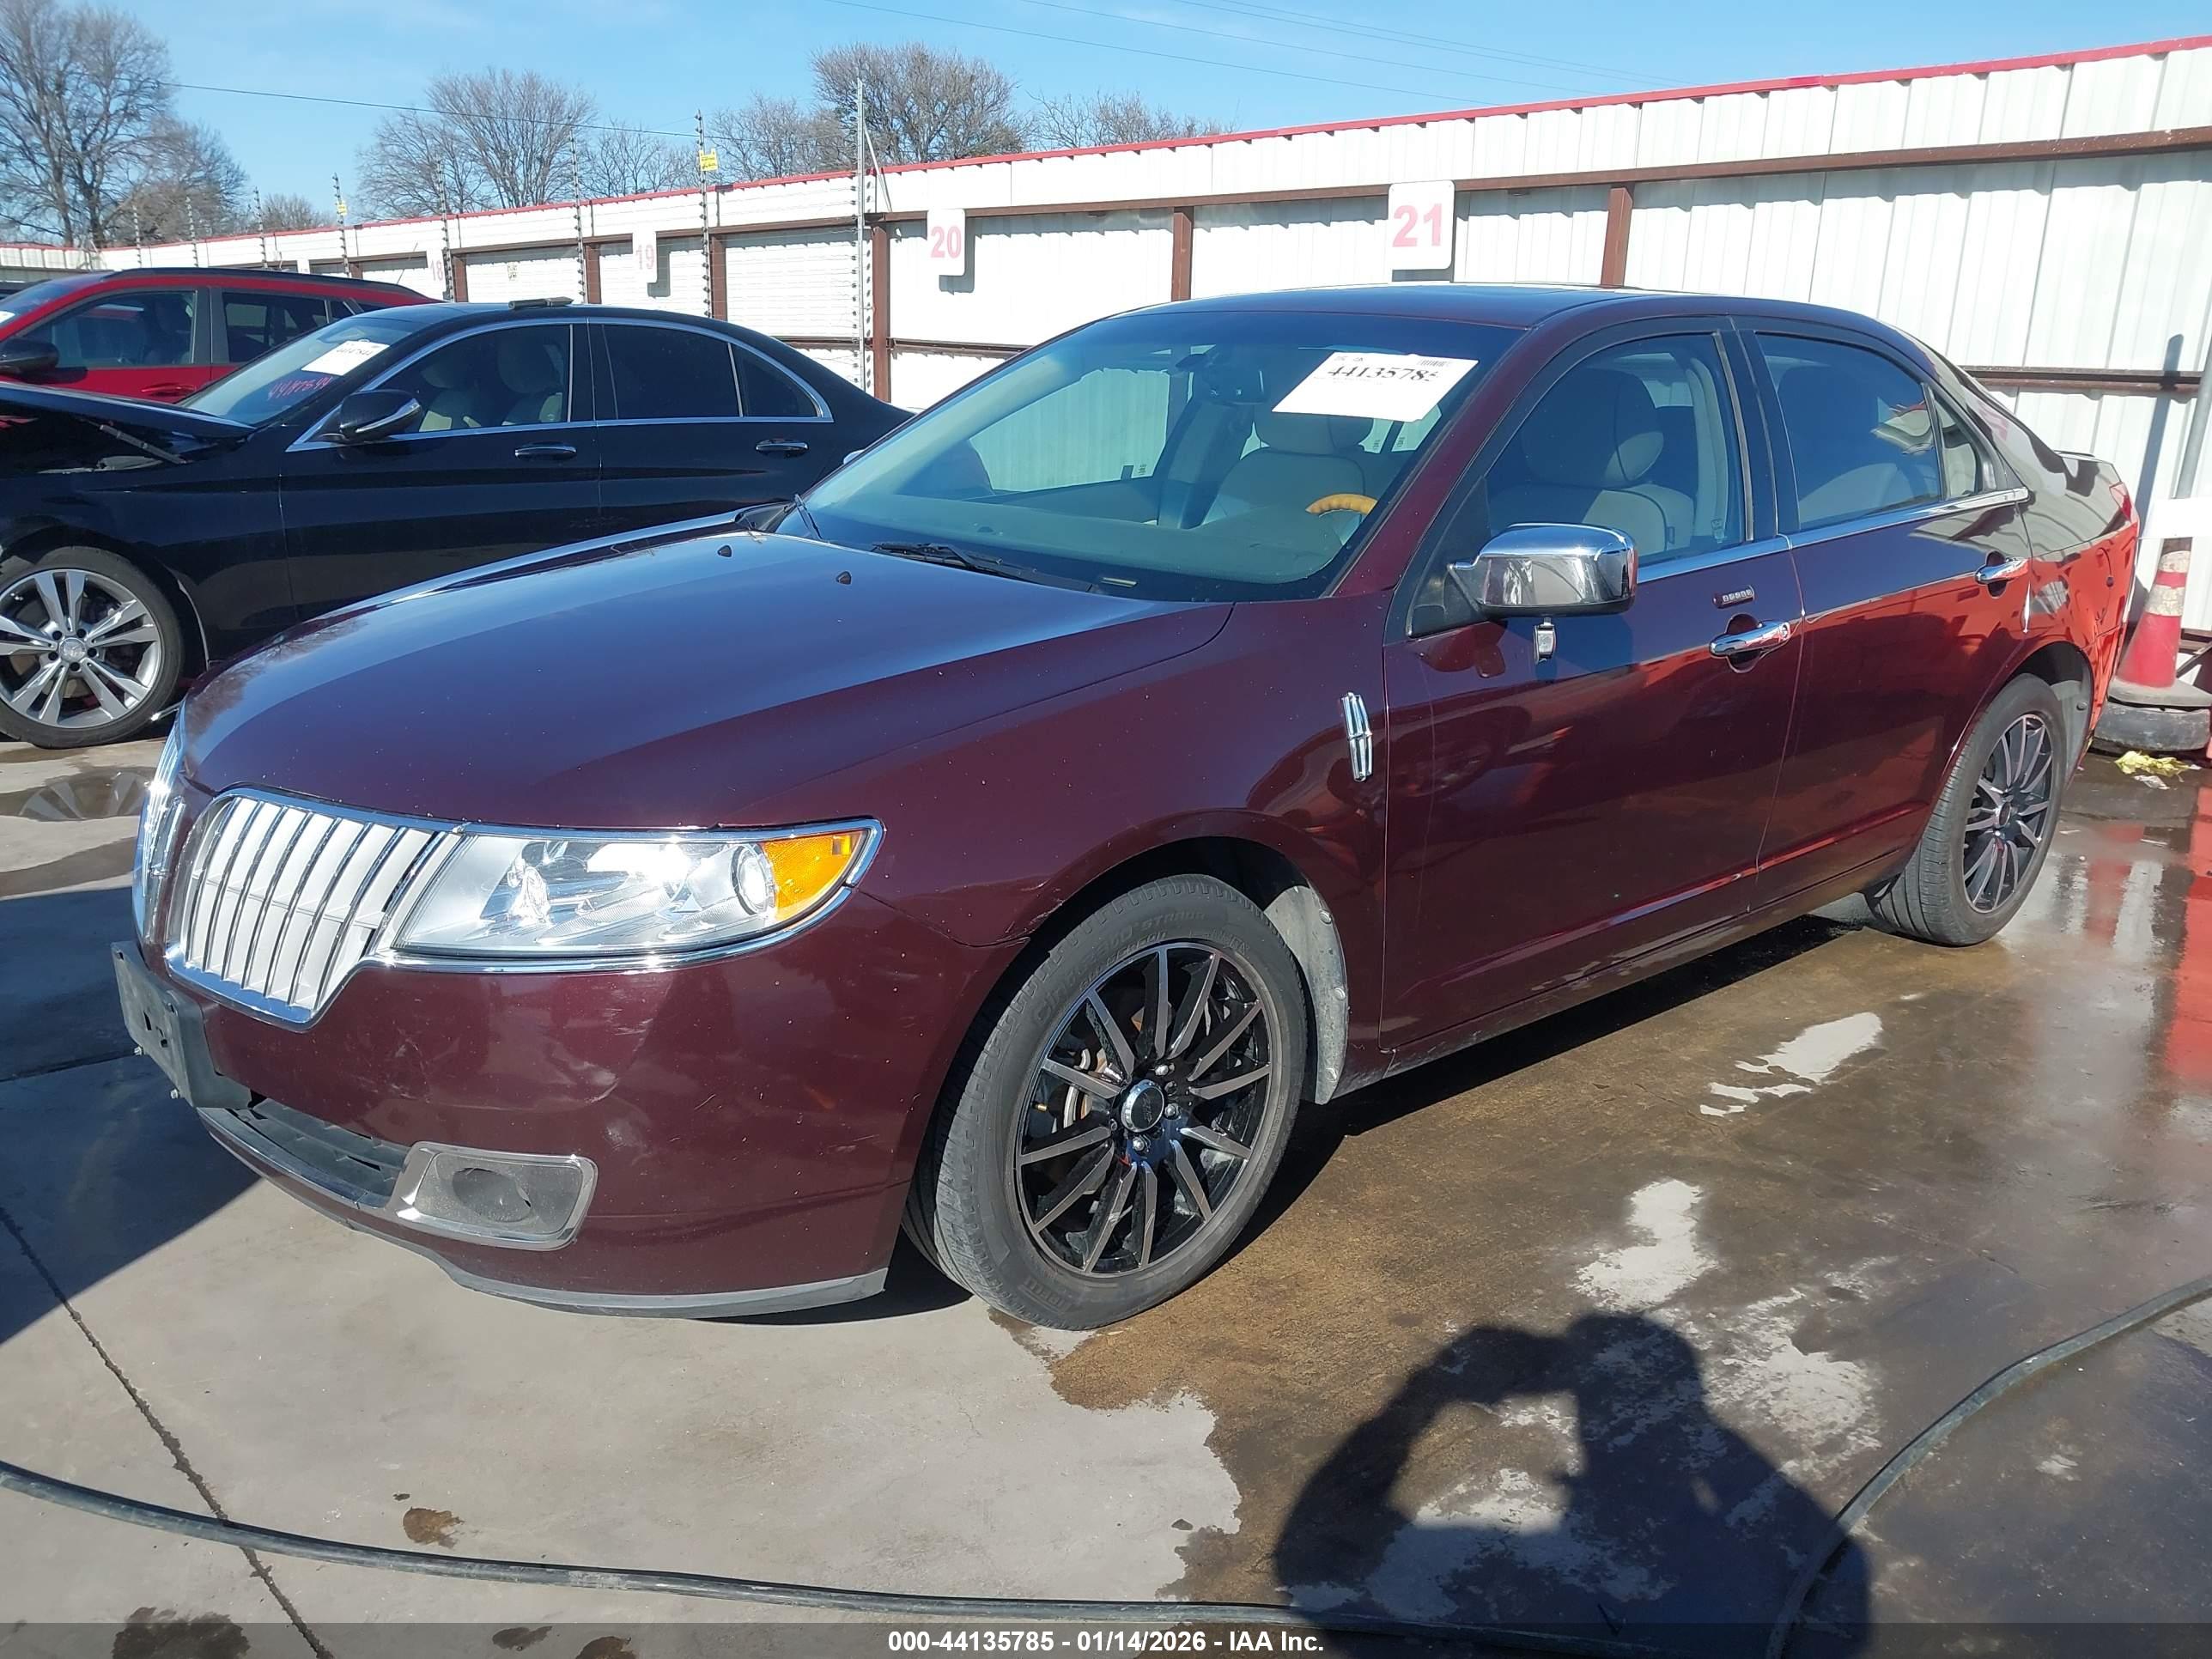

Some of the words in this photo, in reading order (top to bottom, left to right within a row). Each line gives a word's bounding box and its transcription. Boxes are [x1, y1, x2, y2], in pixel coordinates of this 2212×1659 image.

[1393, 204, 1442, 247] 21
[930, 226, 961, 258] 20
[430, 260, 443, 282] 18
[636, 244, 654, 270] 19
